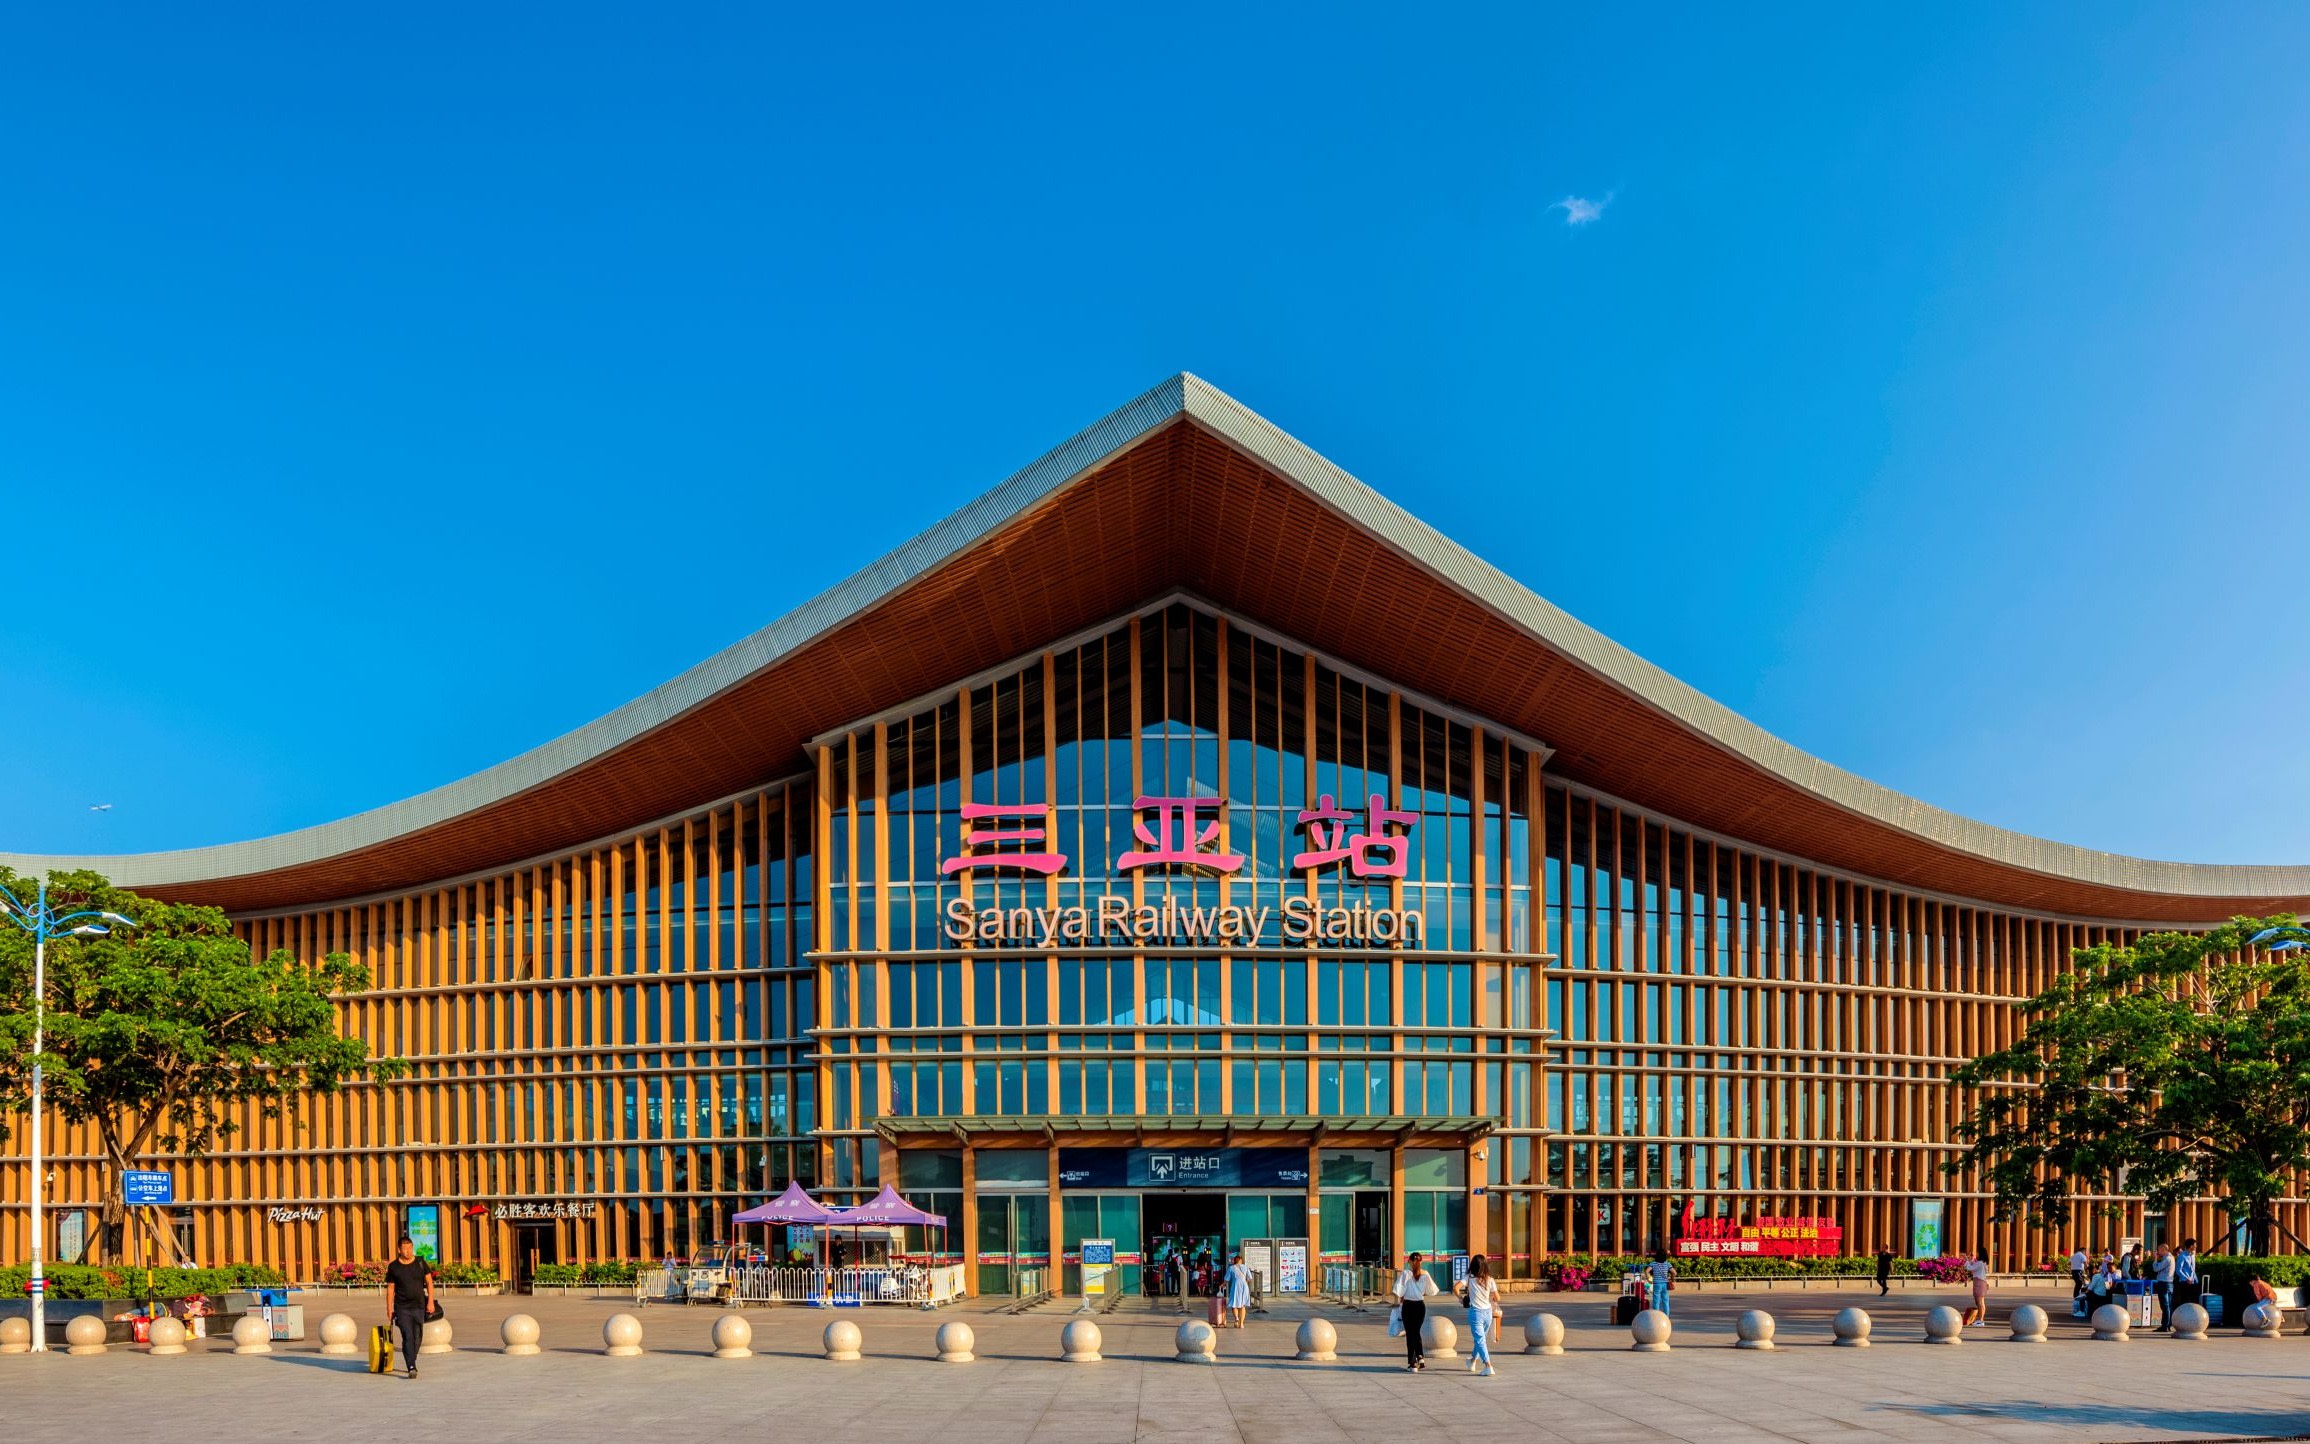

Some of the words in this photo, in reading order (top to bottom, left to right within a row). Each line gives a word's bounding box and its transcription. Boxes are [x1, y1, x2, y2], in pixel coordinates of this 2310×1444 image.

[941, 793, 1420, 877] 三亚站
[944, 898, 1088, 947] Sanya
[1098, 895, 1269, 947] Railway
[1283, 896, 1424, 941] Station
[1179, 1156, 1220, 1170] 进站口
[267, 1207, 300, 1223] Pizza
[301, 1206, 327, 1221] Hut
[494, 1202, 595, 1219] 必胜客欢乐餐厅
[1742, 1228, 1760, 1238] 自由
[1761, 1228, 1780, 1238] 平等
[1781, 1228, 1799, 1238] 公正
[1800, 1228, 1819, 1238] 法治
[1680, 1242, 1699, 1252] 富强
[1701, 1242, 1719, 1252] 民主
[1720, 1242, 1739, 1252] 文明
[1740, 1241, 1759, 1252] 和谐
